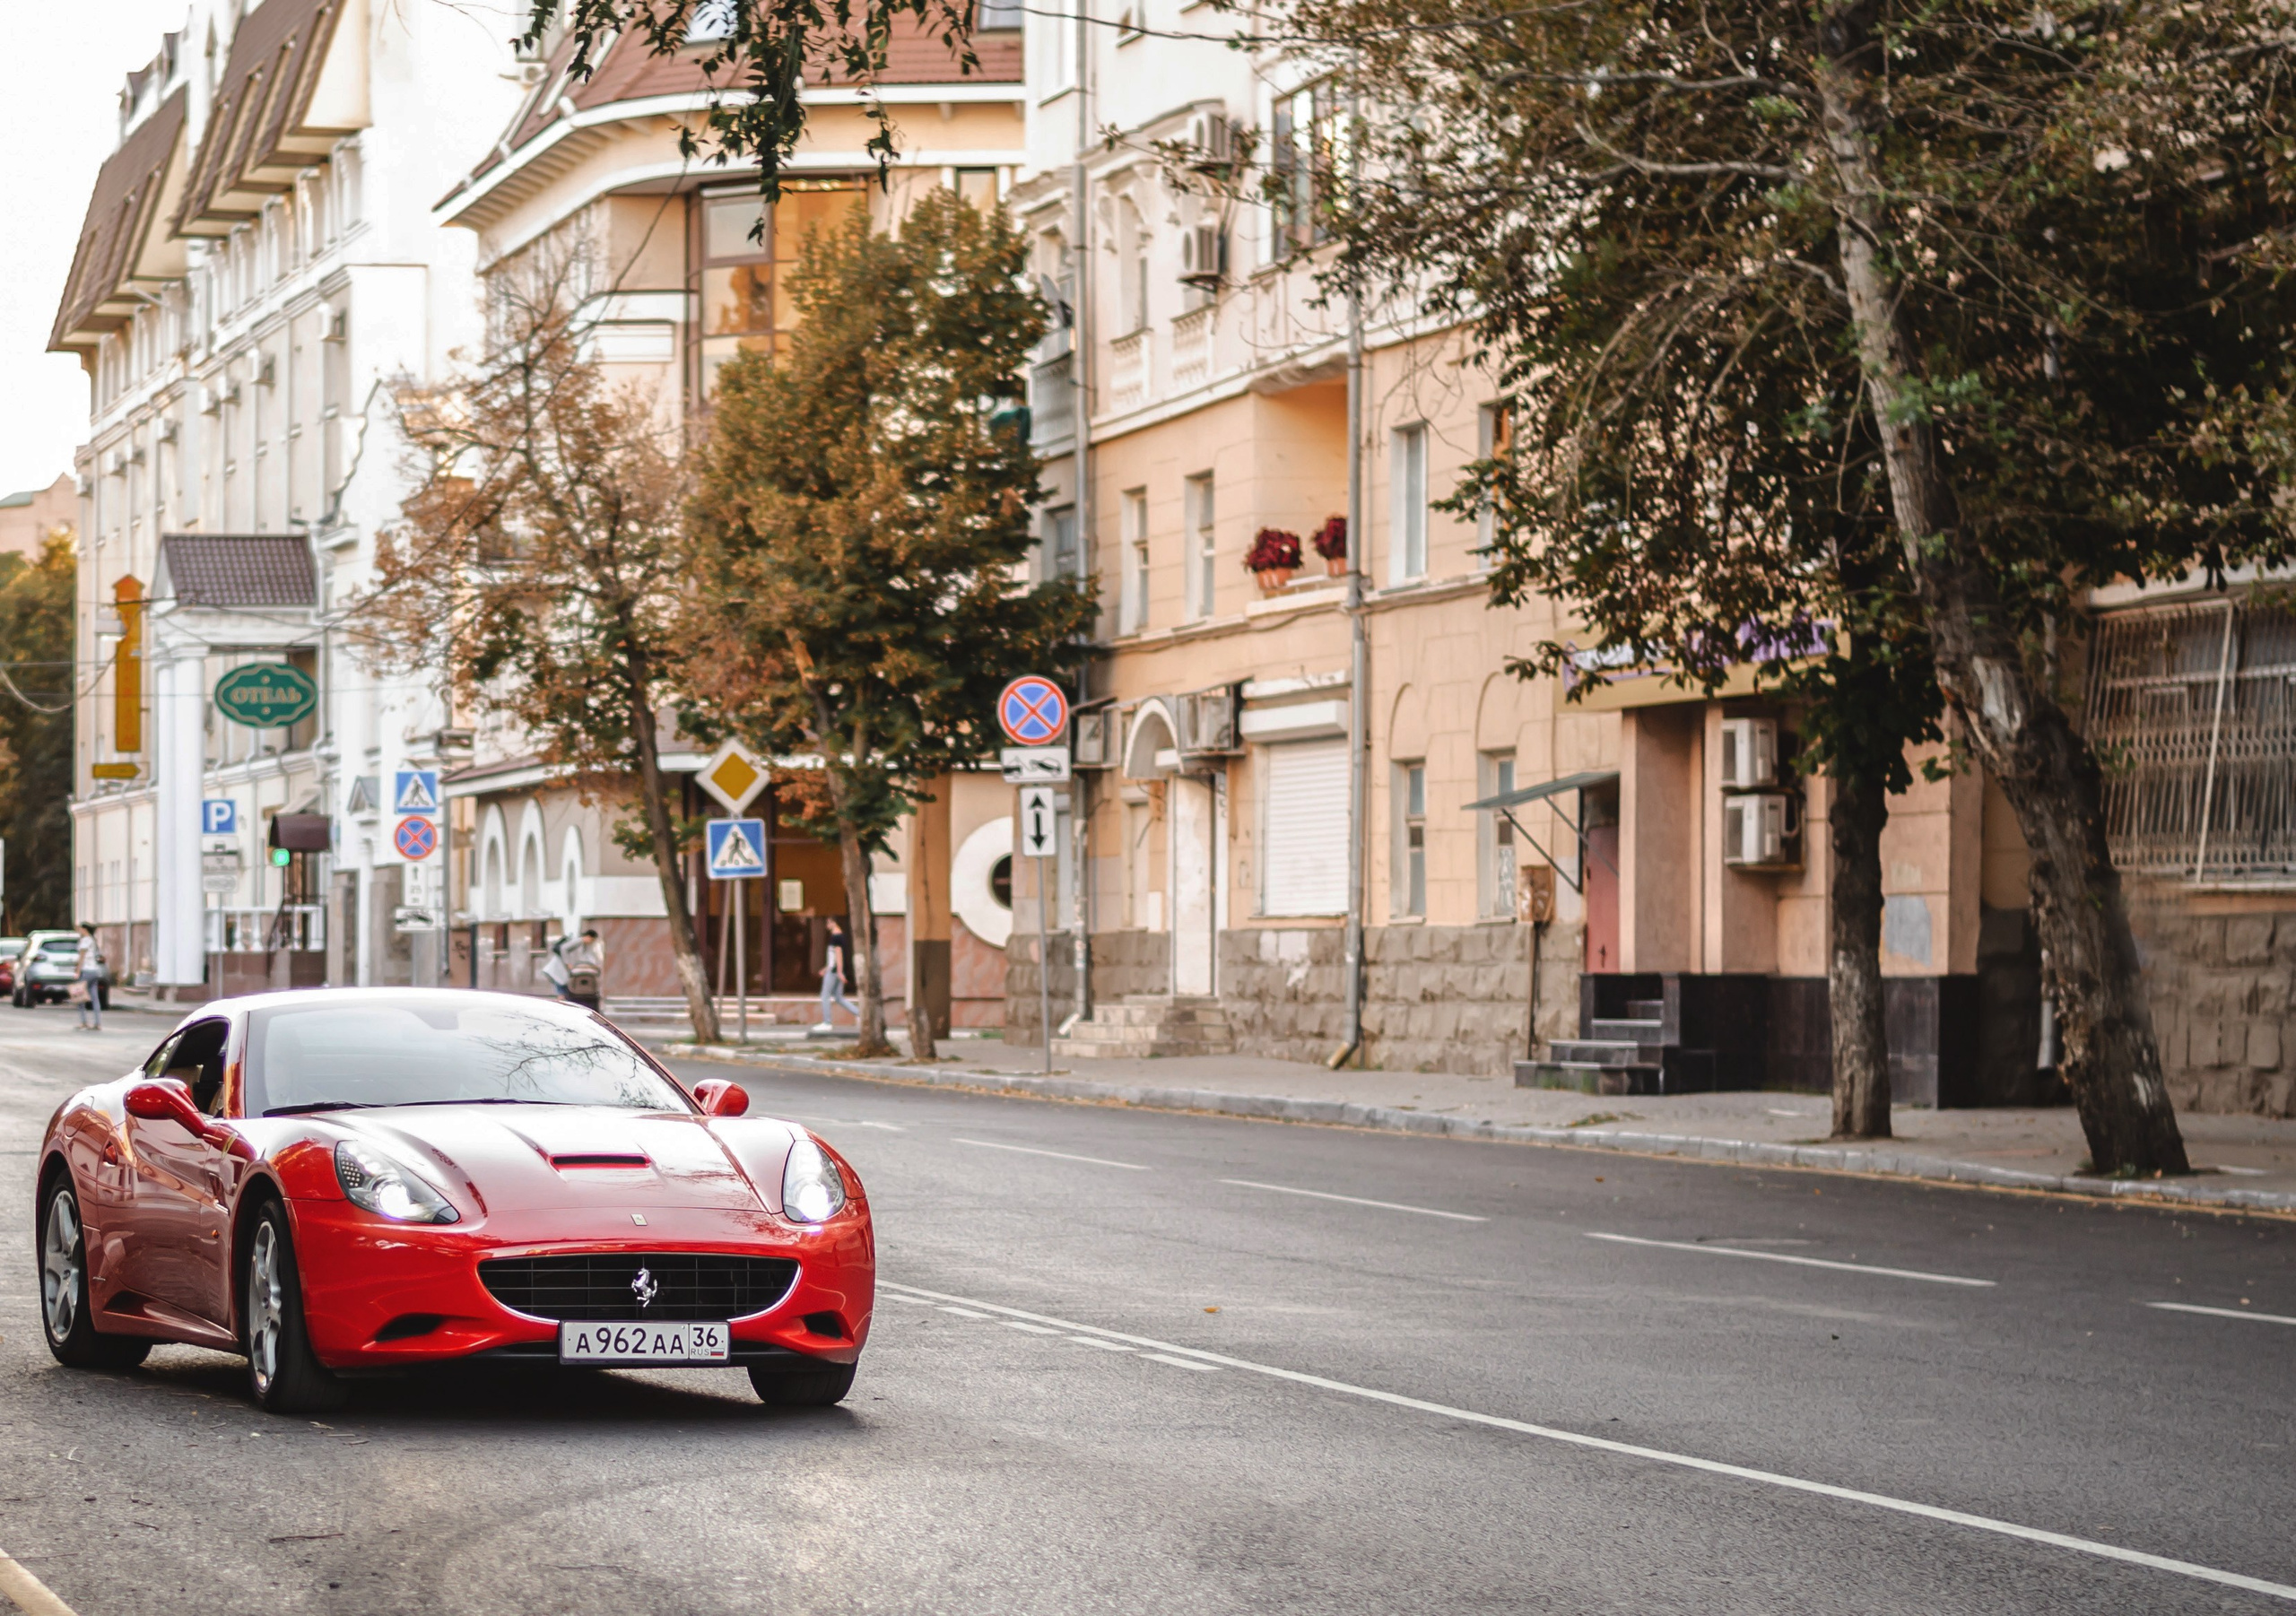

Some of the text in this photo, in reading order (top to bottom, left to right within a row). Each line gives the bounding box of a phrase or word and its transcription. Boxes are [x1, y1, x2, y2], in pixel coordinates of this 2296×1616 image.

[230, 686, 302, 704] ОТЕЛЬ
[210, 802, 231, 831] P
[692, 1327, 718, 1348] 36
[691, 1348, 710, 1356] RUS
